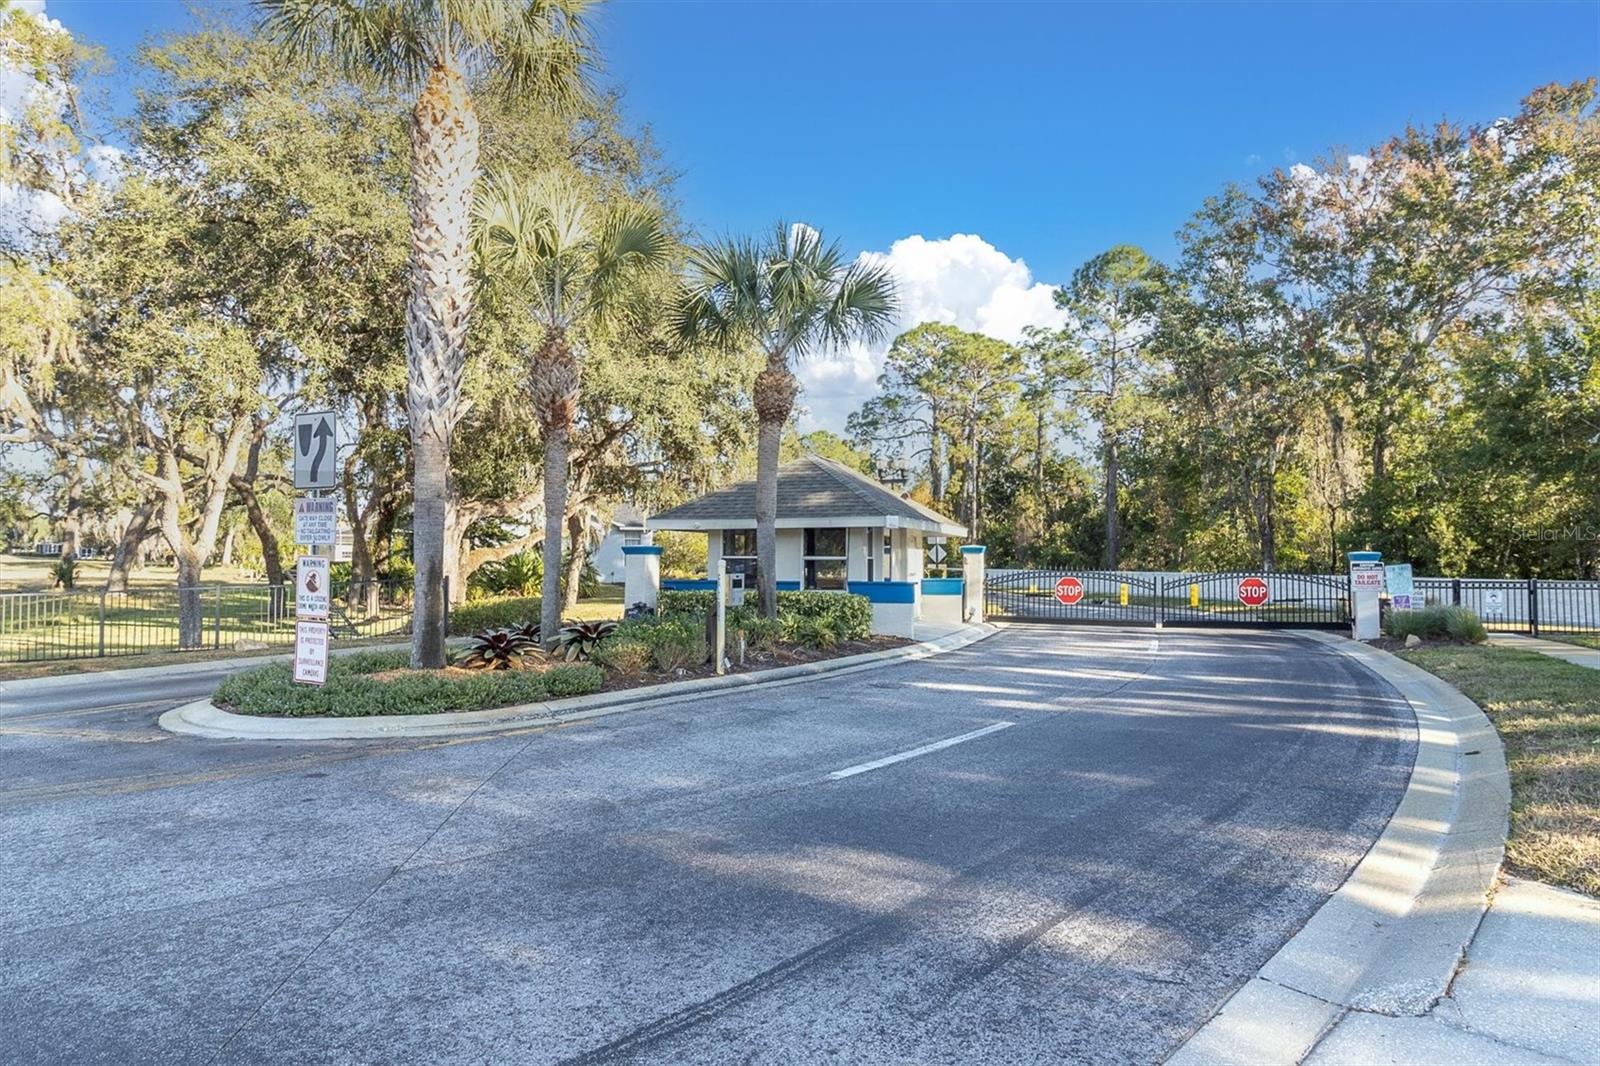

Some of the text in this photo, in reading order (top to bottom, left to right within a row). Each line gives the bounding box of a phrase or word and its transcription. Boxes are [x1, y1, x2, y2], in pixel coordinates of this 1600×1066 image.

[306, 501, 334, 513] WARNING
[302, 560, 326, 568] WARNING
[1057, 585, 1081, 596] STOP
[1240, 586, 1266, 598] STOP
